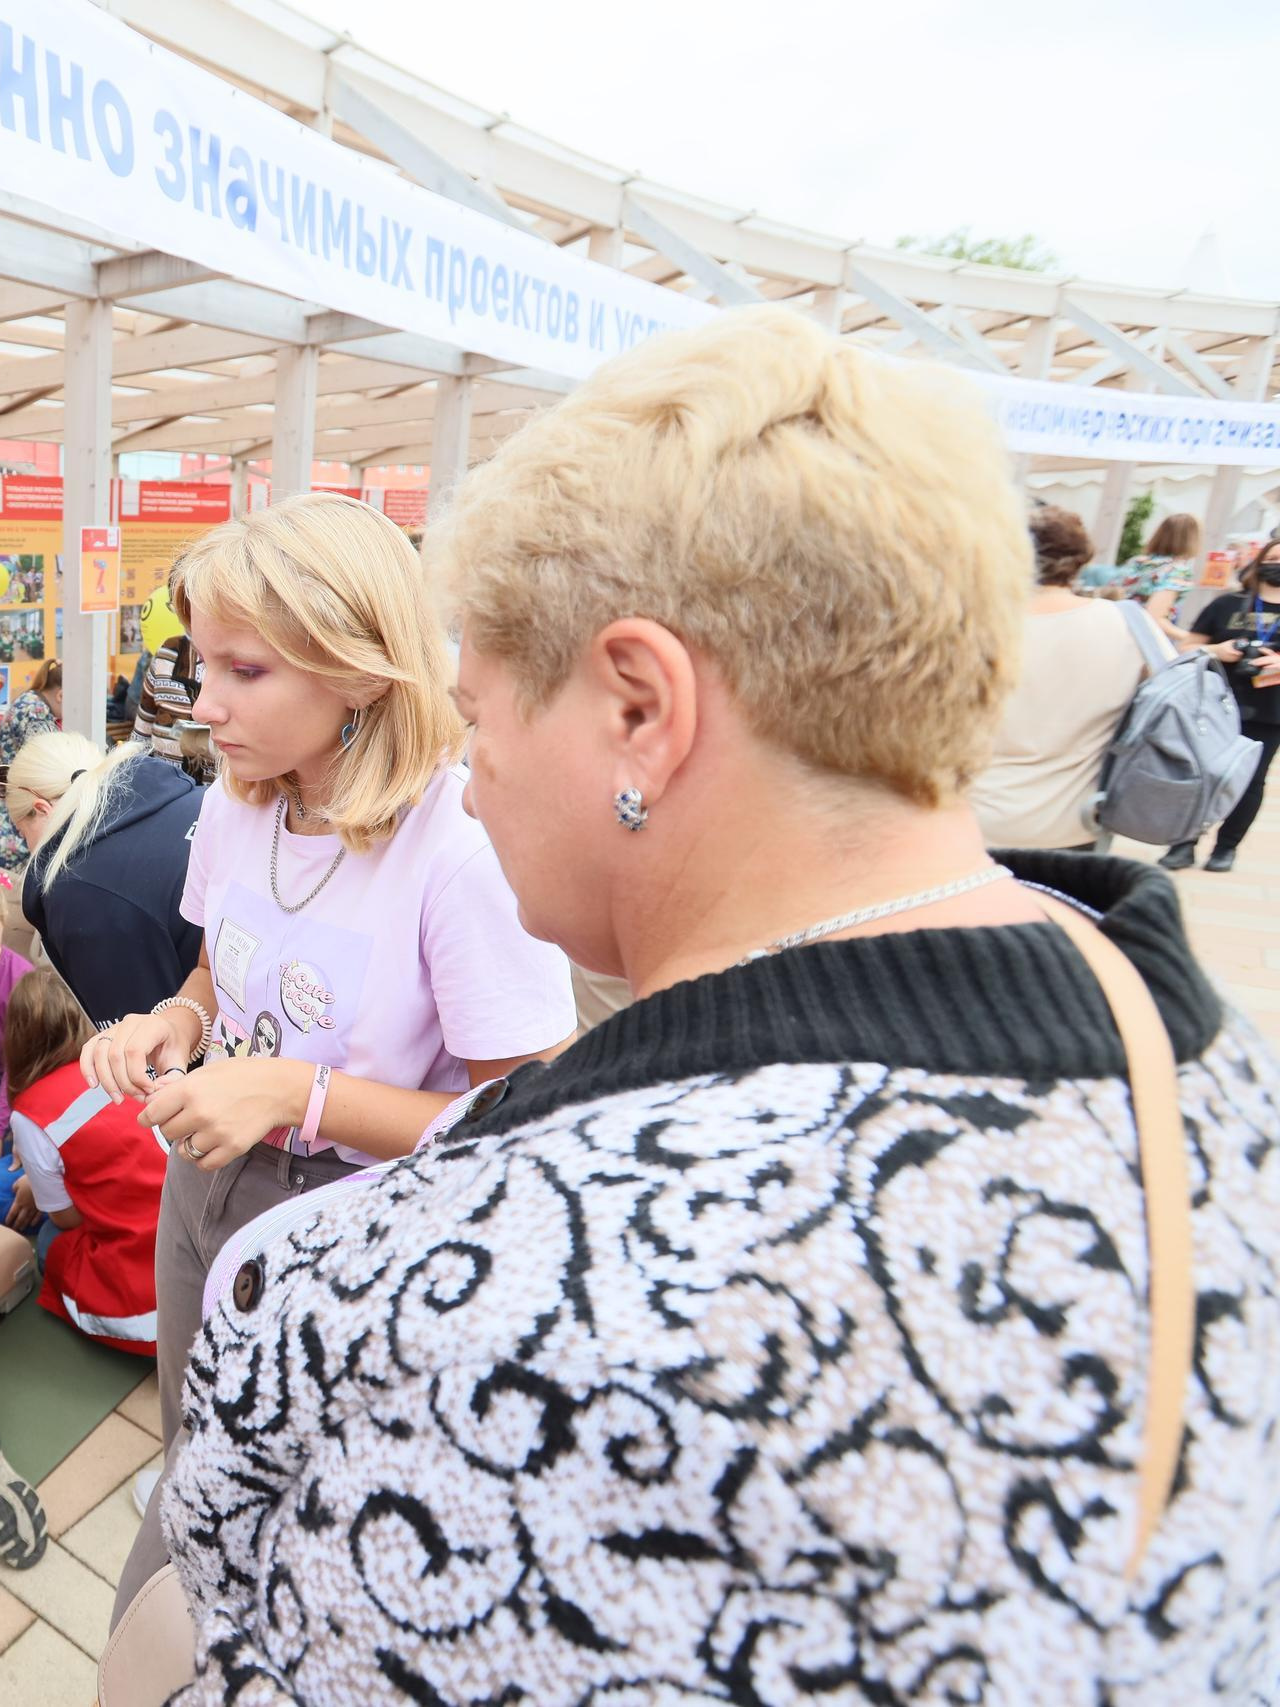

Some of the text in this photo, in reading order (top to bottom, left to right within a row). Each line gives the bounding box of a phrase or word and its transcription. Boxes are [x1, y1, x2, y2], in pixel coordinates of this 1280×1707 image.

[153, 108, 415, 291] значимых
[424, 233, 579, 344] проектов
[588, 297, 606, 352] и
[294, 972, 336, 1004] Cute
[291, 991, 336, 1030] Care
